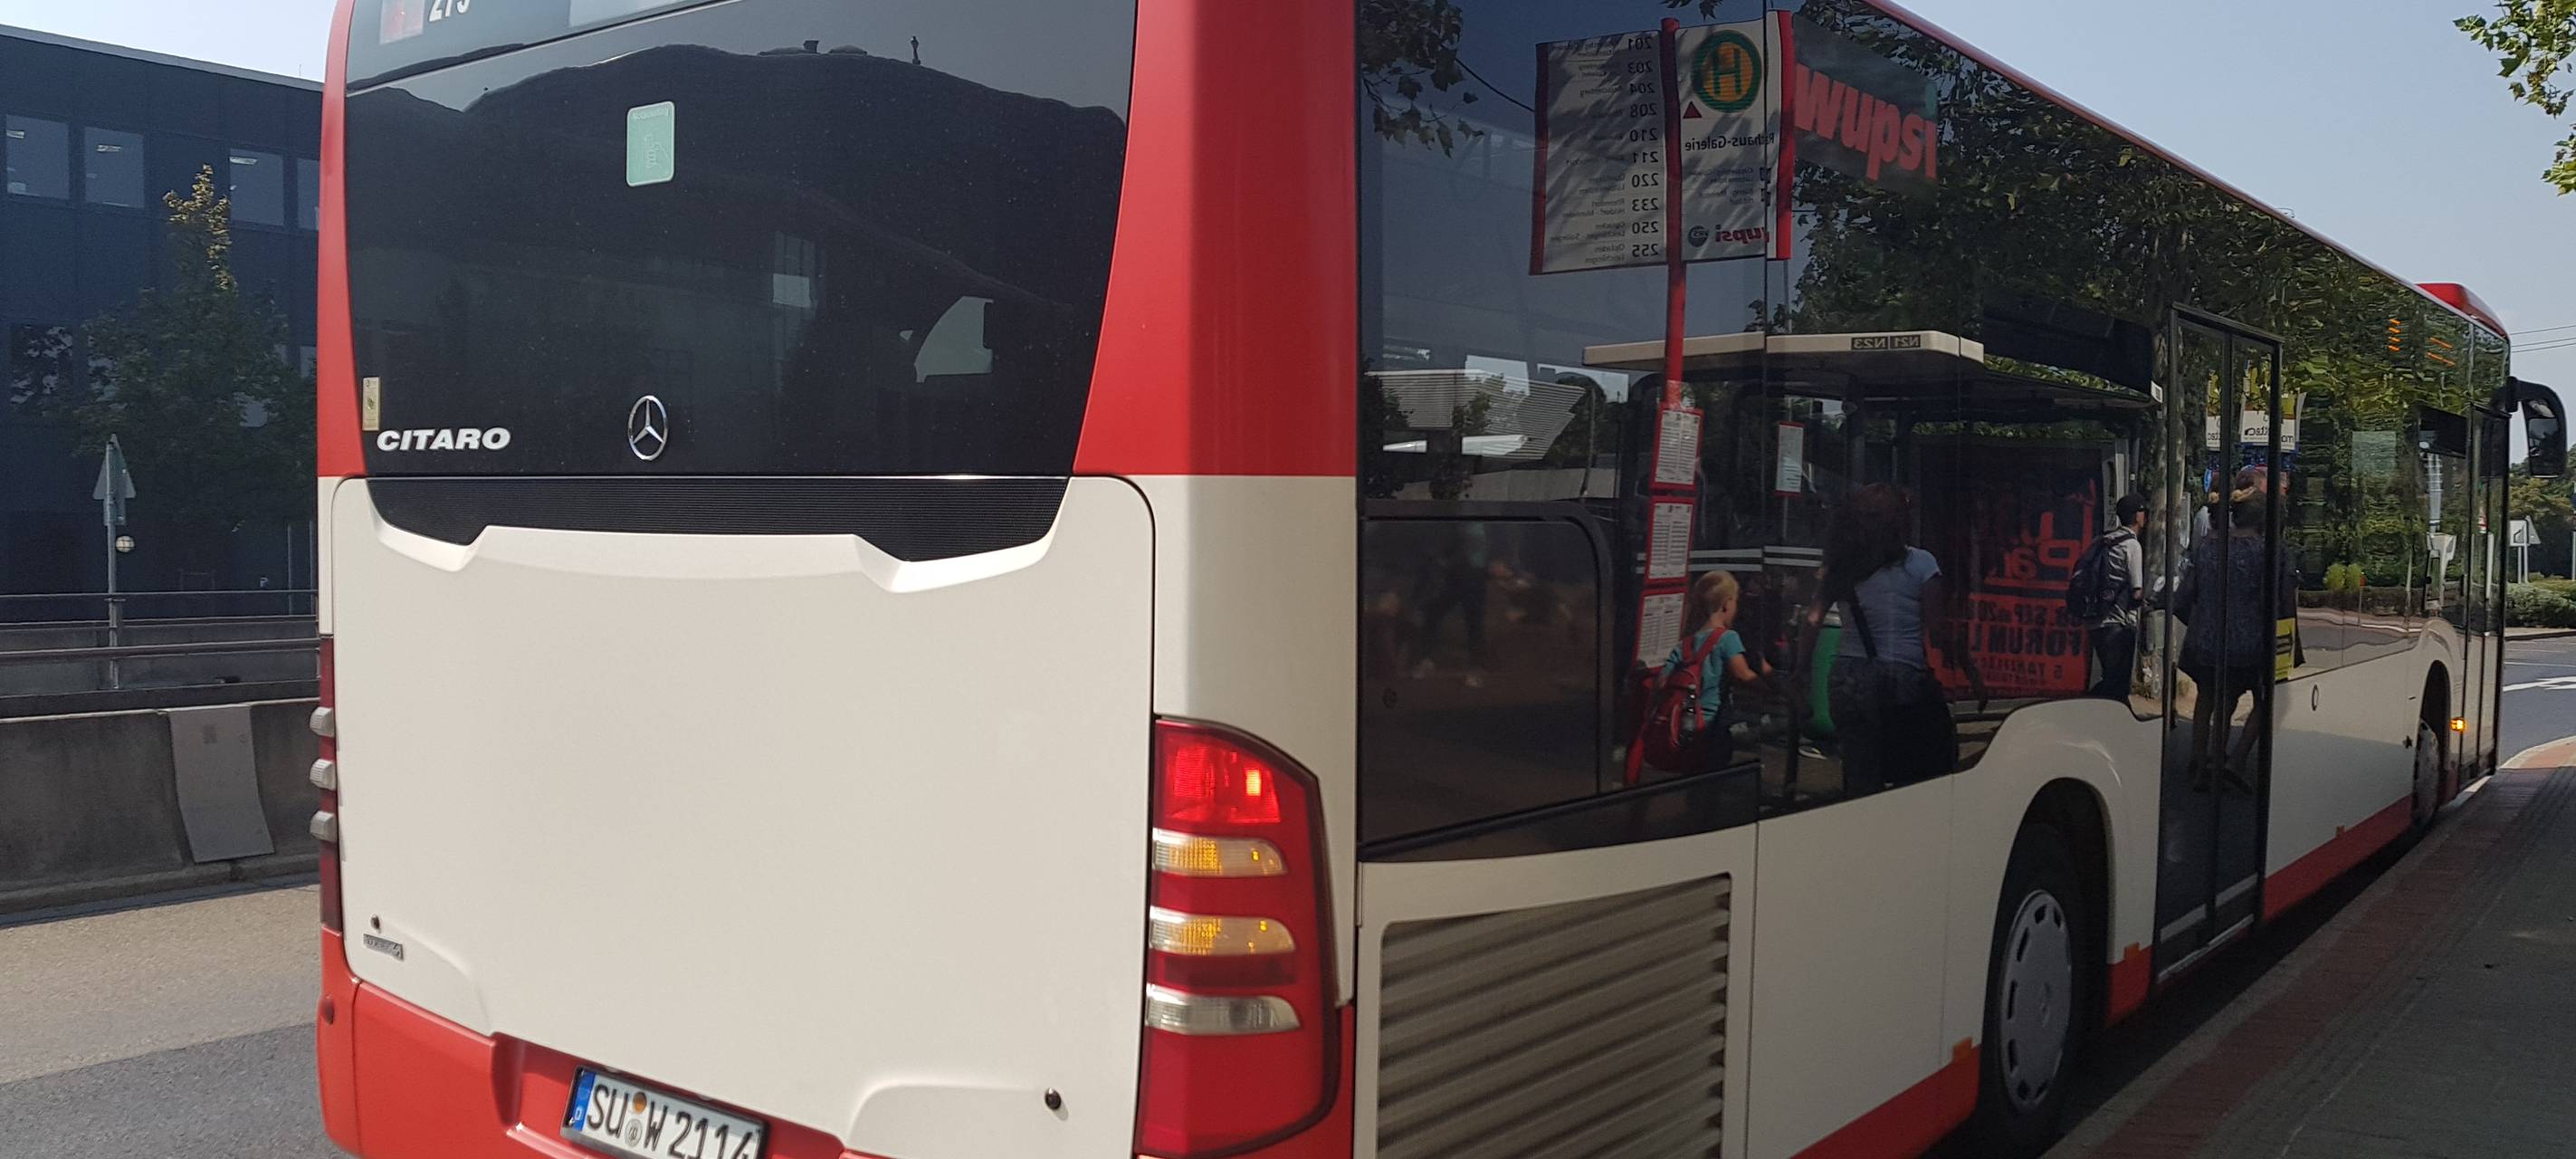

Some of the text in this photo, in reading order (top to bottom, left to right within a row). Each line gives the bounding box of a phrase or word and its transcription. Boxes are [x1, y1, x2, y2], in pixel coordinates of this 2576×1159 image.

[1794, 62, 1937, 180] wupsi
[377, 427, 511, 451] CITARO
[575, 1107, 584, 1121] D
[587, 1084, 629, 1138] SU
[644, 1100, 668, 1152] W
